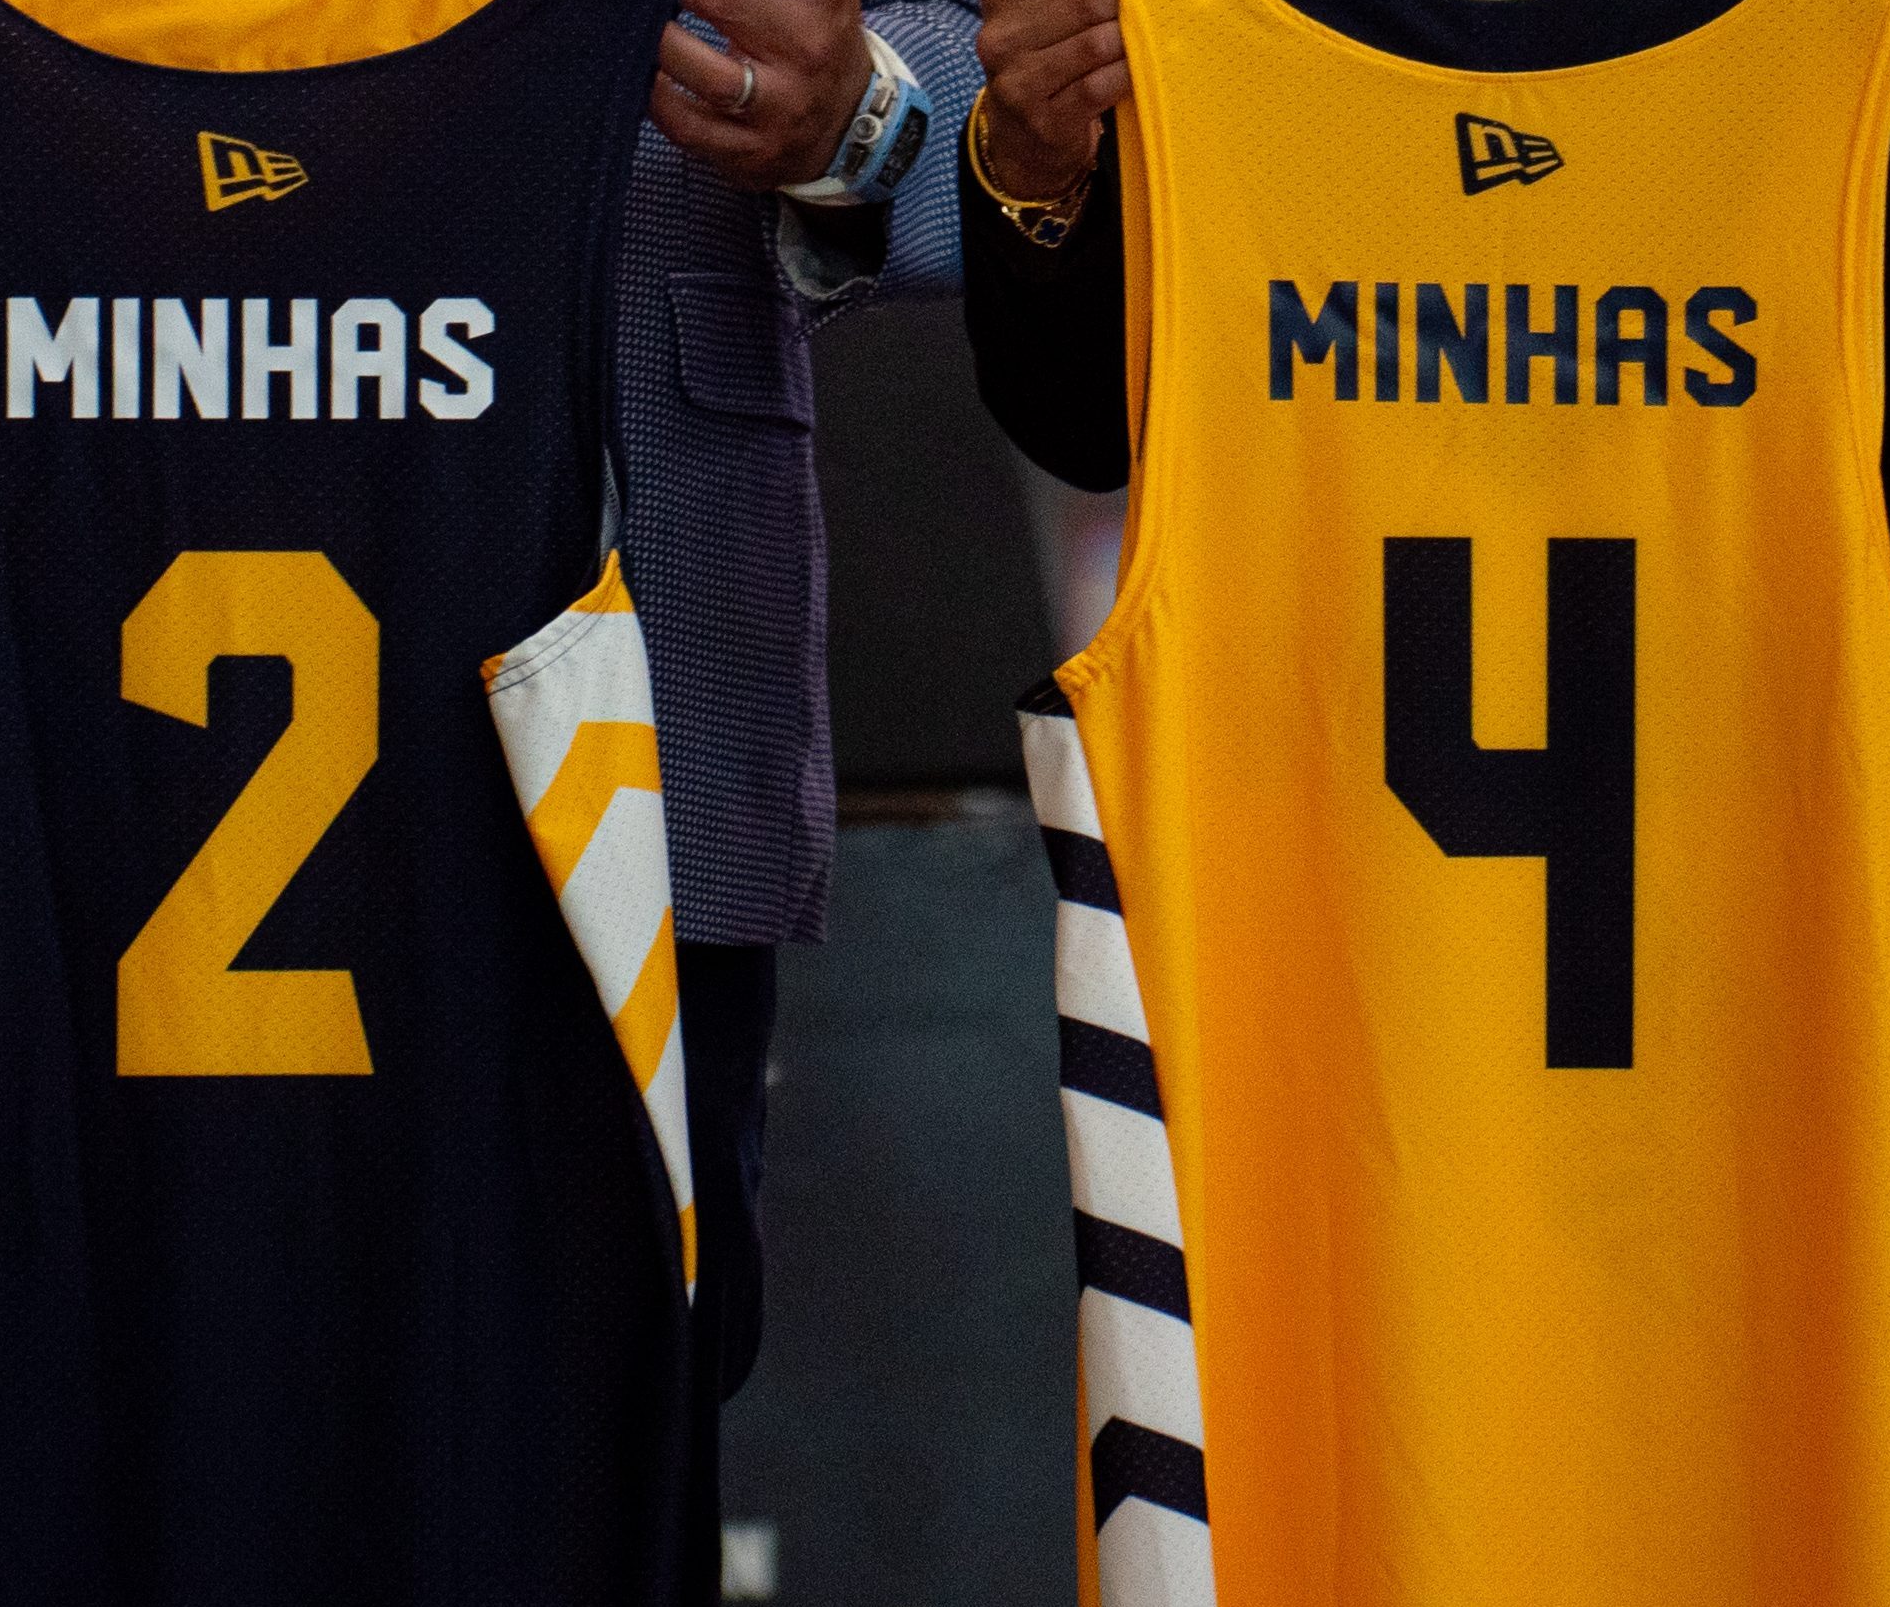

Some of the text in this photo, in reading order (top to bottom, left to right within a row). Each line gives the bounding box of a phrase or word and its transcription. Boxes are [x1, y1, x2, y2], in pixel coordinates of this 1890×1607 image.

[6, 297, 495, 420] MINHAS
[1268, 279, 1758, 408] MINHAS
[117, 551, 380, 1076] 2
[1383, 537, 1637, 1070] 4
